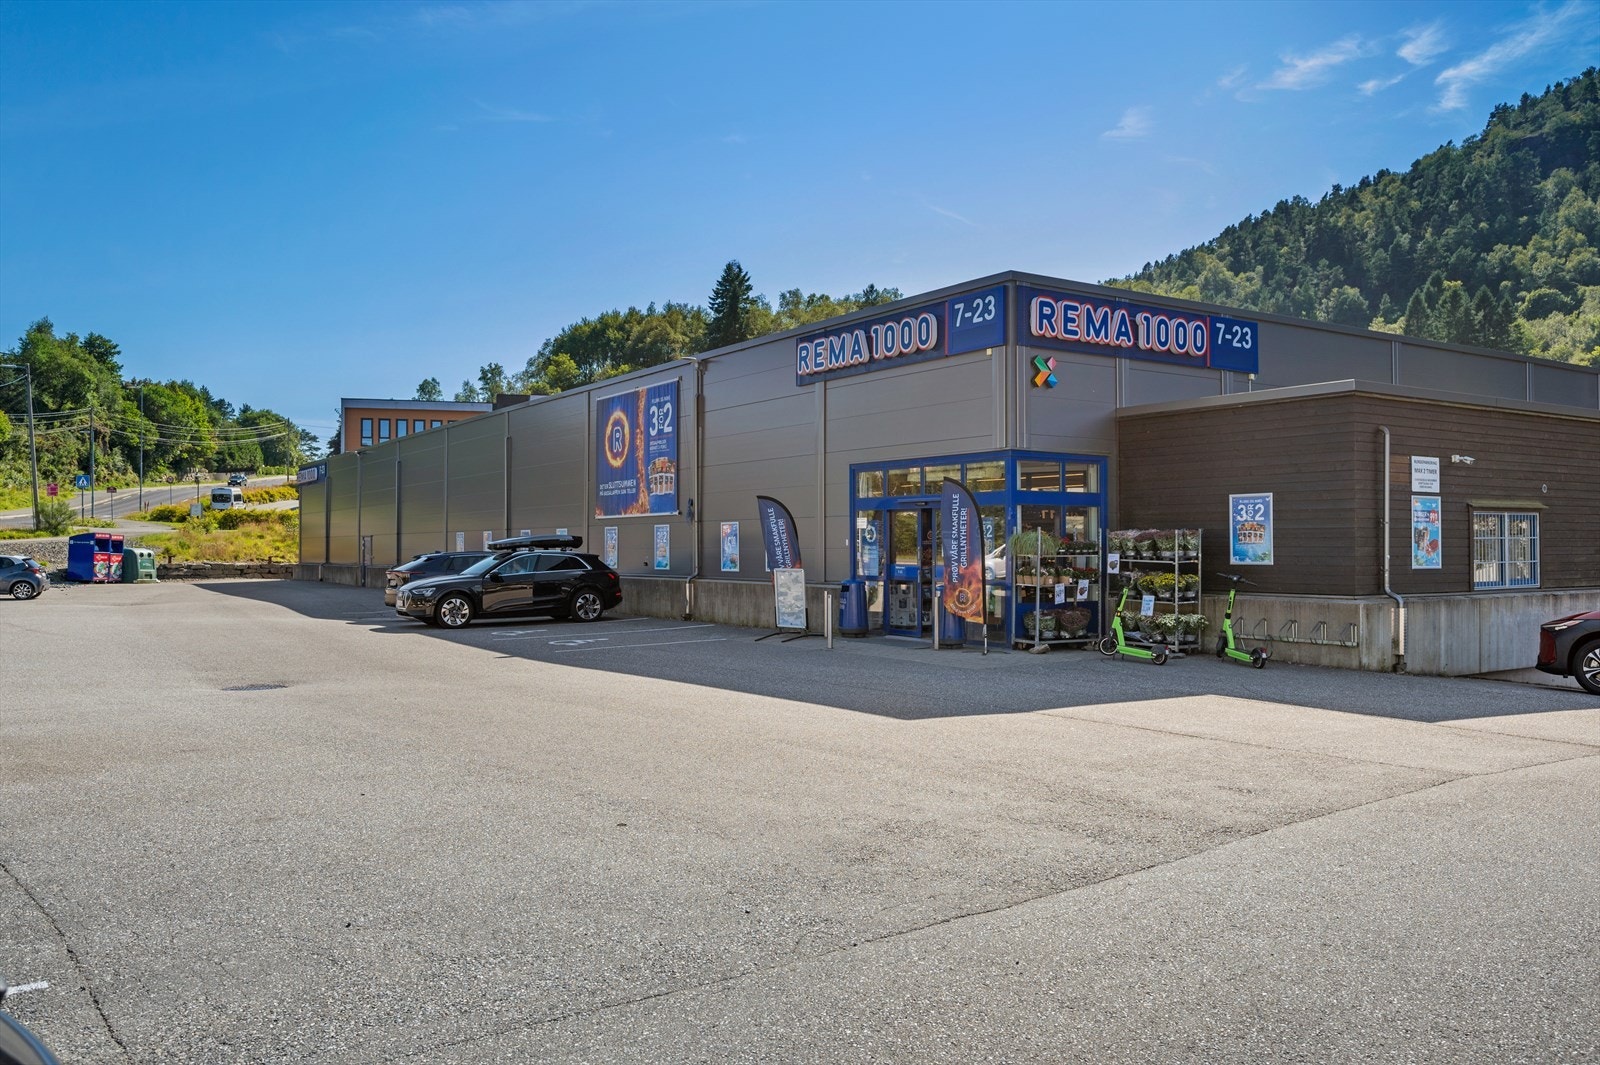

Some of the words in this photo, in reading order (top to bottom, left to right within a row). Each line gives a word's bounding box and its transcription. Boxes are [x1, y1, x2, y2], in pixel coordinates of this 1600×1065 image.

[954, 295, 996, 327] 7-23
[1030, 294, 1134, 348] REMA
[1136, 310, 1207, 356] 1000
[797, 329, 869, 376] REMA
[870, 311, 937, 360] 1000
[1215, 322, 1252, 350] 7-23
[649, 405, 658, 437] 3
[663, 402, 673, 433] 2
[612, 426, 623, 453] R
[767, 507, 781, 544] SMAKFULLE
[951, 493, 960, 539] SMAKFULLE
[1237, 504, 1247, 521] 3
[1247, 504, 1255, 521] FOR
[1254, 503, 1265, 521] 2
[959, 507, 968, 569] GRILLNYHETER!
[986, 524, 993, 538] 2
[775, 544, 783, 565] VÅRE
[951, 540, 959, 562] VÅRE
